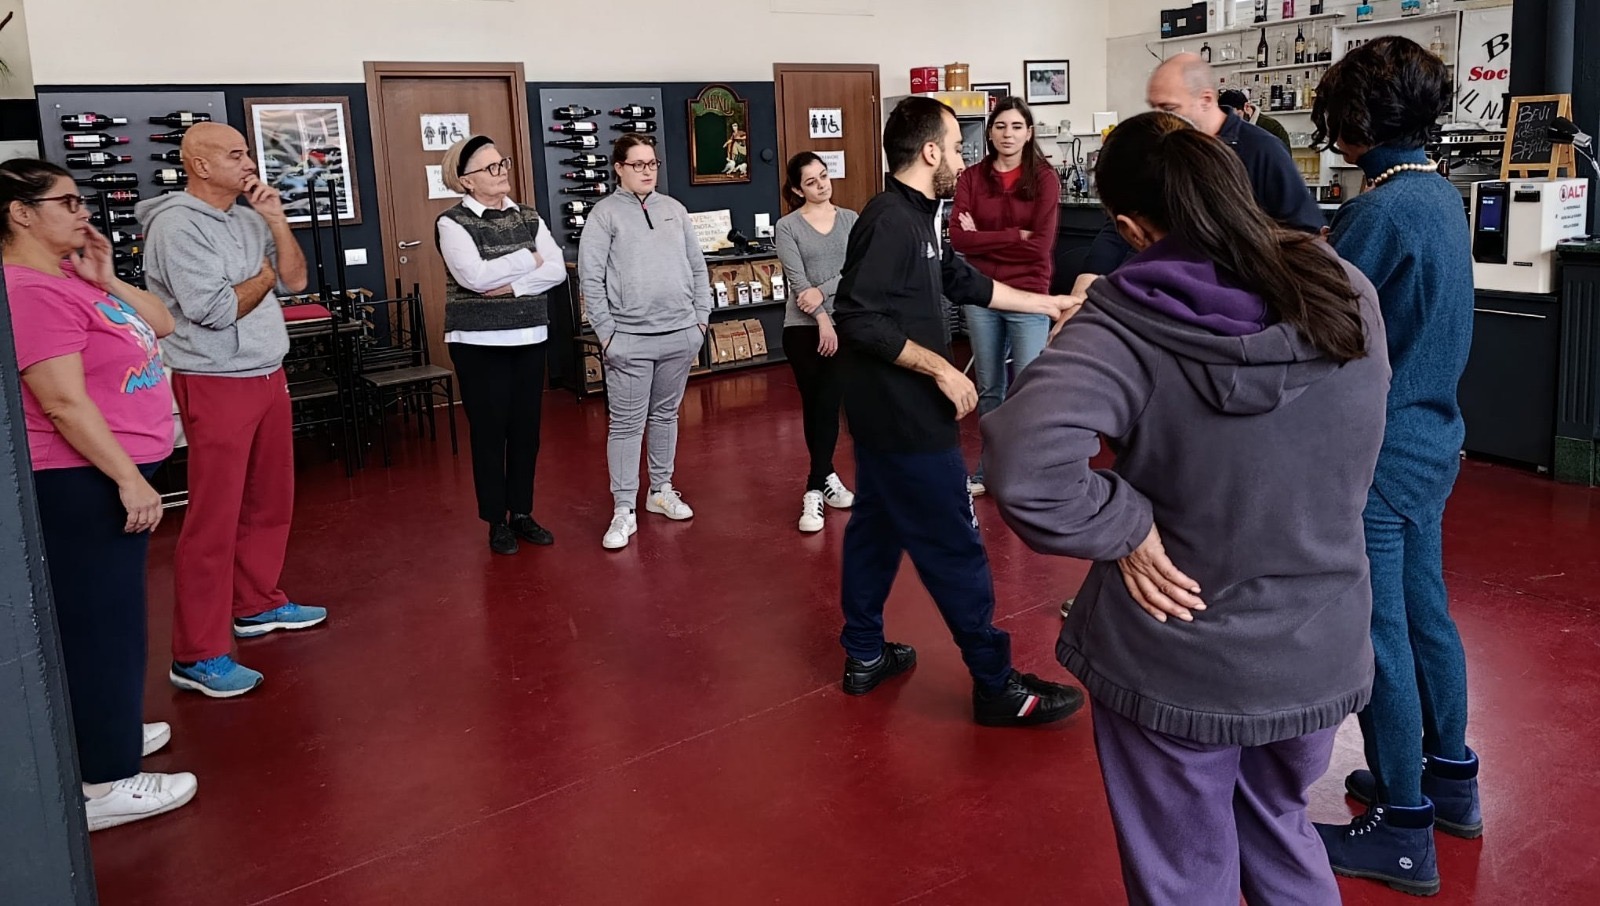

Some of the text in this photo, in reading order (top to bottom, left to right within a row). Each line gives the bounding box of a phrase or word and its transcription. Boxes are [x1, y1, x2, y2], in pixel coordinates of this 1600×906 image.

[1482, 33, 1510, 63] B
[1468, 65, 1508, 82] Soc
[702, 94, 734, 116] MENU
[1480, 100, 1504, 120] N
